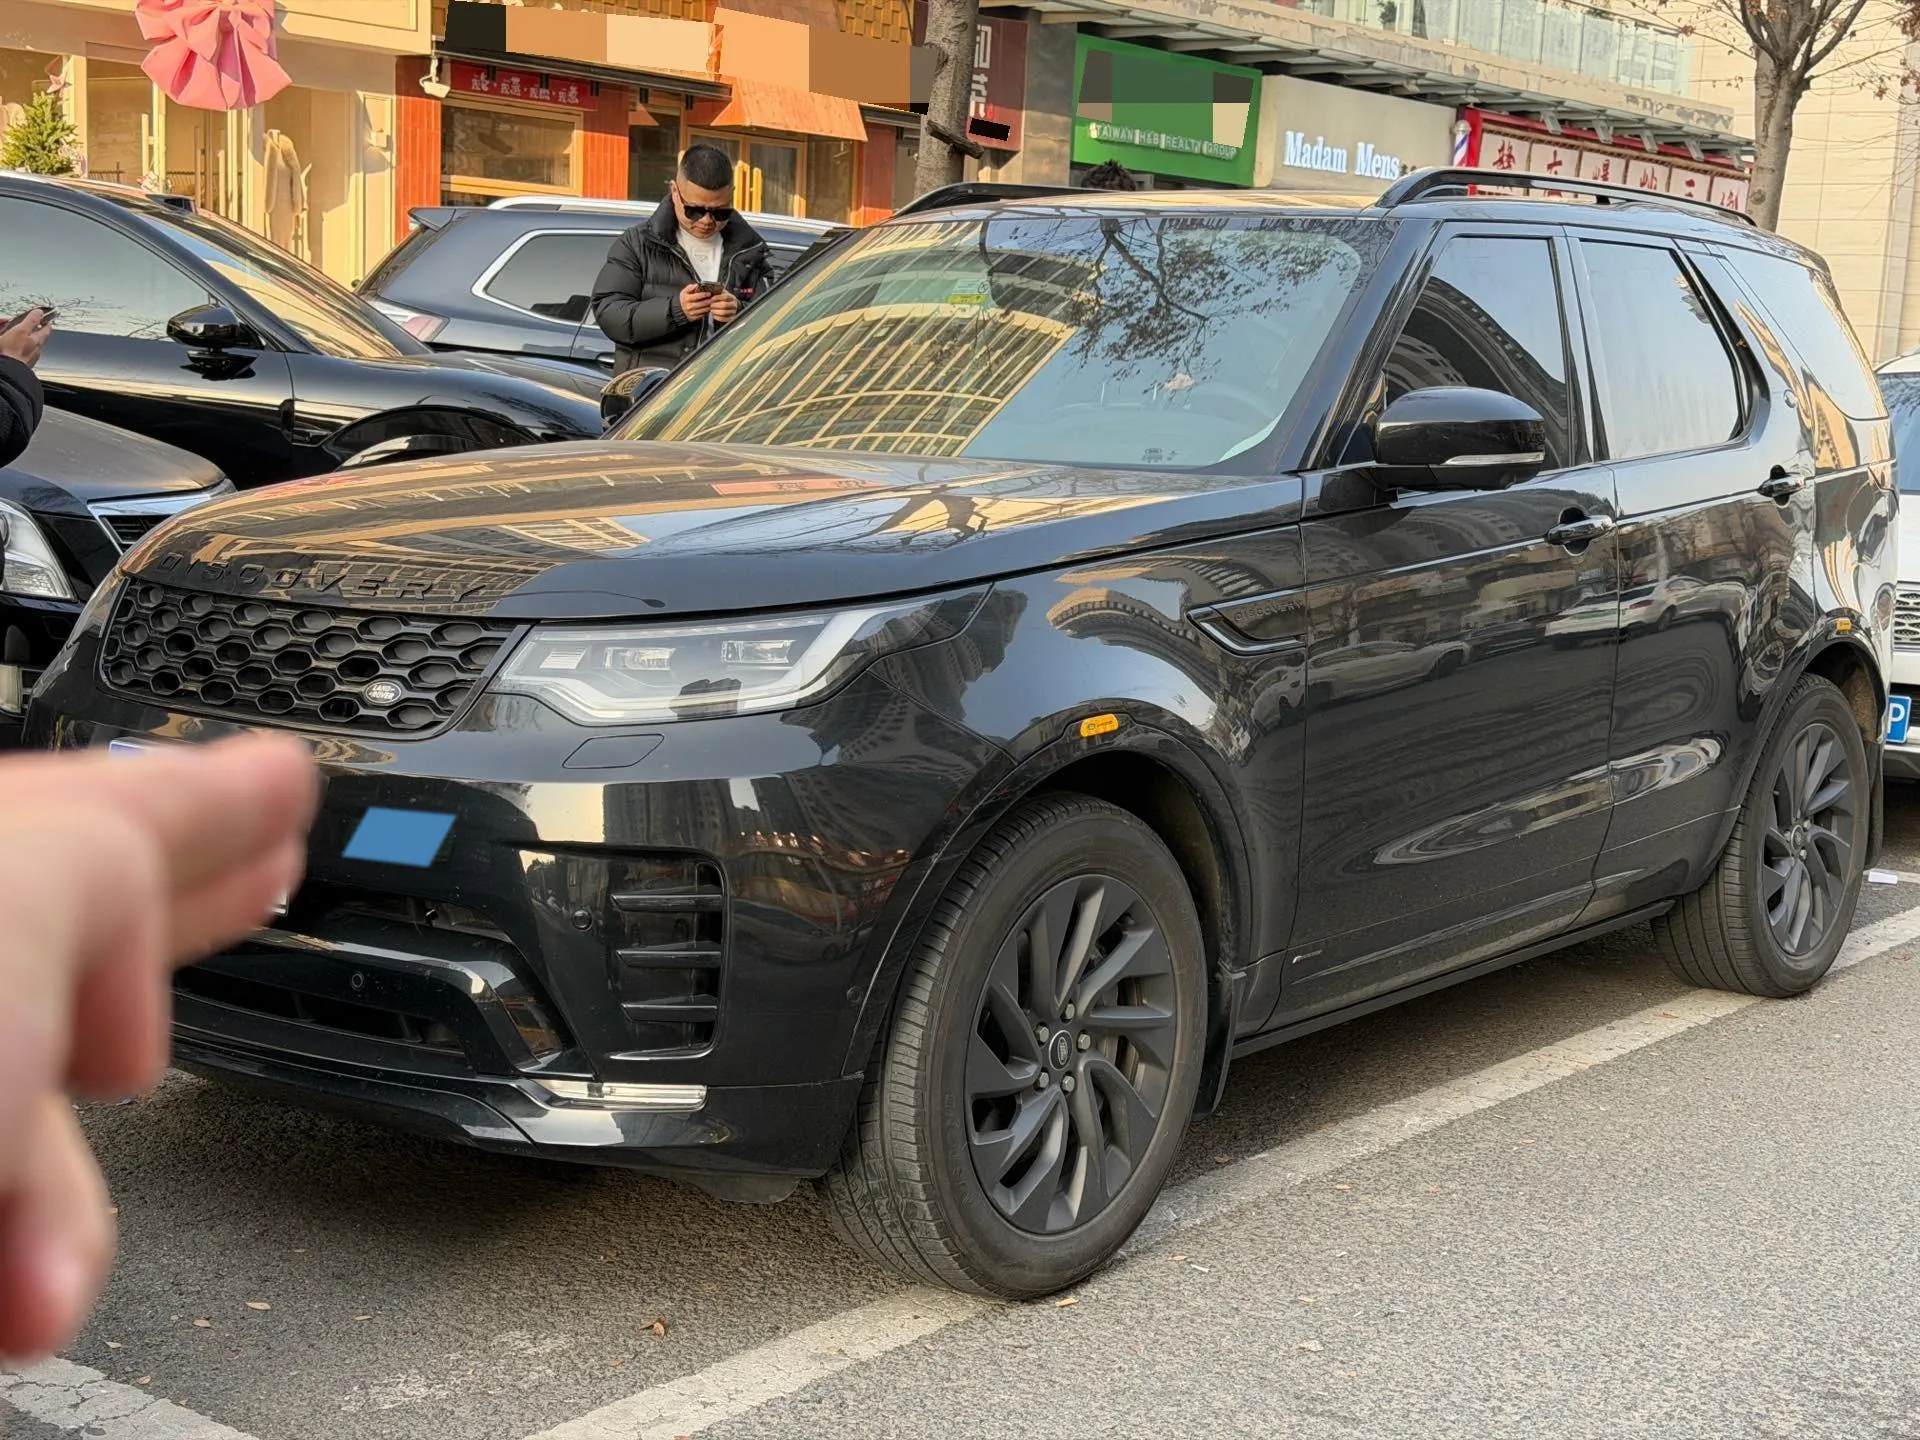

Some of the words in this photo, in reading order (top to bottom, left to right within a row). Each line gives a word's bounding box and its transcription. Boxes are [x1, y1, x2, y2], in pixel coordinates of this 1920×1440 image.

[1093, 122, 1134, 141] TAIWAN
[1165, 134, 1202, 154] REALTY
[1283, 130, 1348, 173] Madam
[1354, 141, 1400, 180] Mens
[157, 550, 487, 602] DISCOVERY
[1234, 599, 1304, 621] DISCOVERY
[1887, 703, 1905, 733] P
